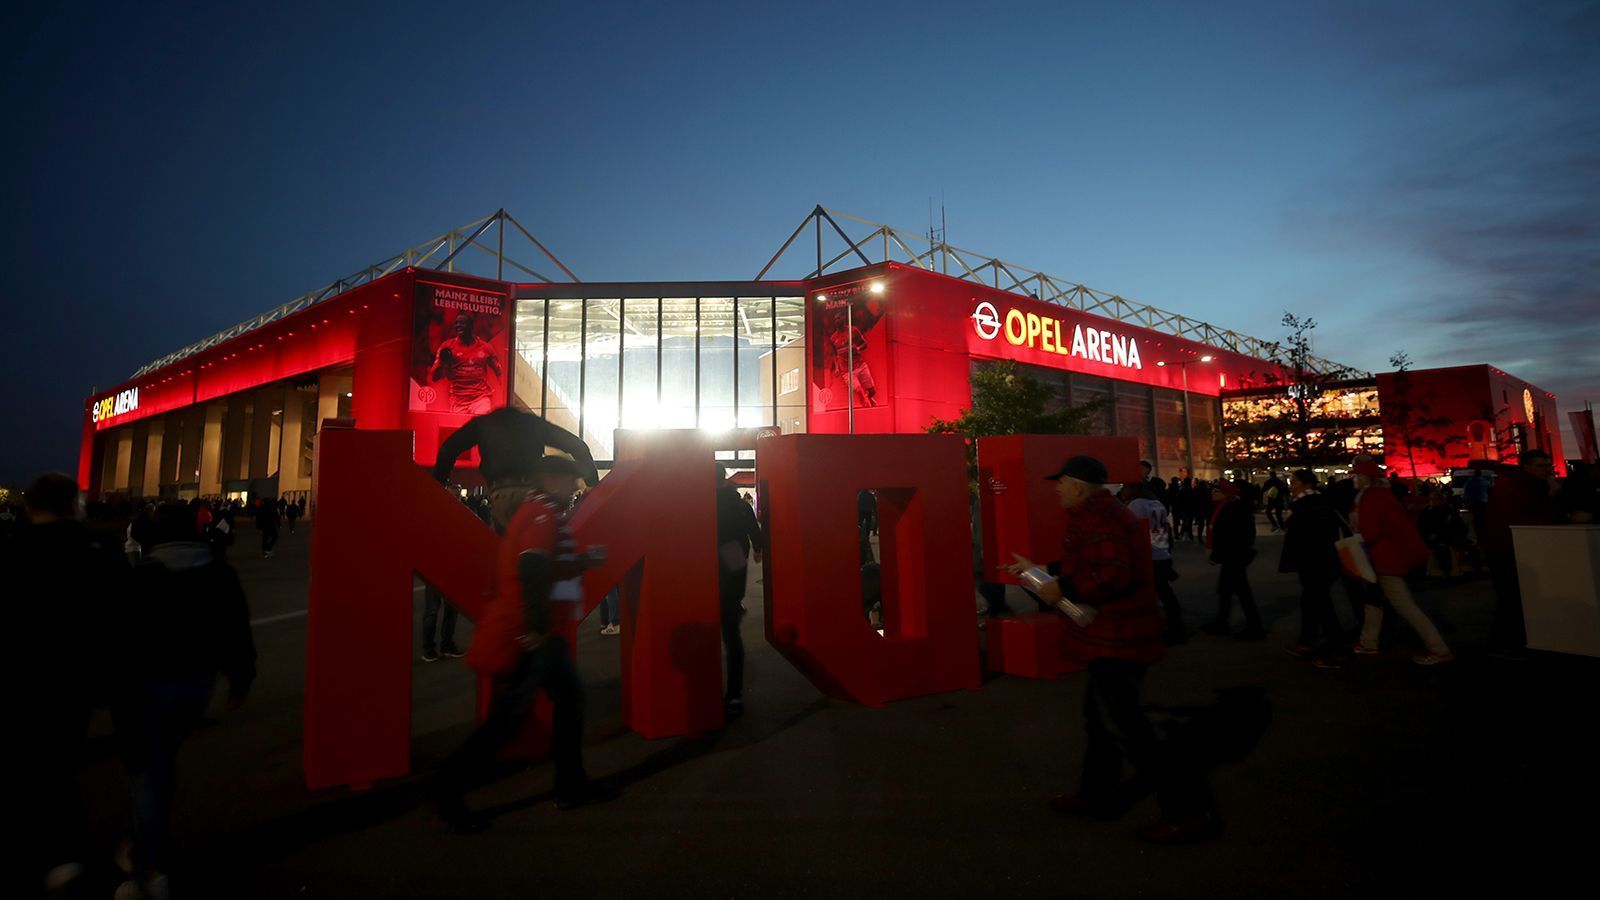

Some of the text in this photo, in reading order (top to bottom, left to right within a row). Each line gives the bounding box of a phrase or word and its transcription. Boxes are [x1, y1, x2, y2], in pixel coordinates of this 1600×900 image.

[434, 298, 502, 316] LEBENSLUSTIG.
[435, 288, 500, 306] MAINZ BLEIBT.
[1004, 307, 1142, 370] OPEL ARENA
[98, 386, 138, 421] OPEL ARENA
